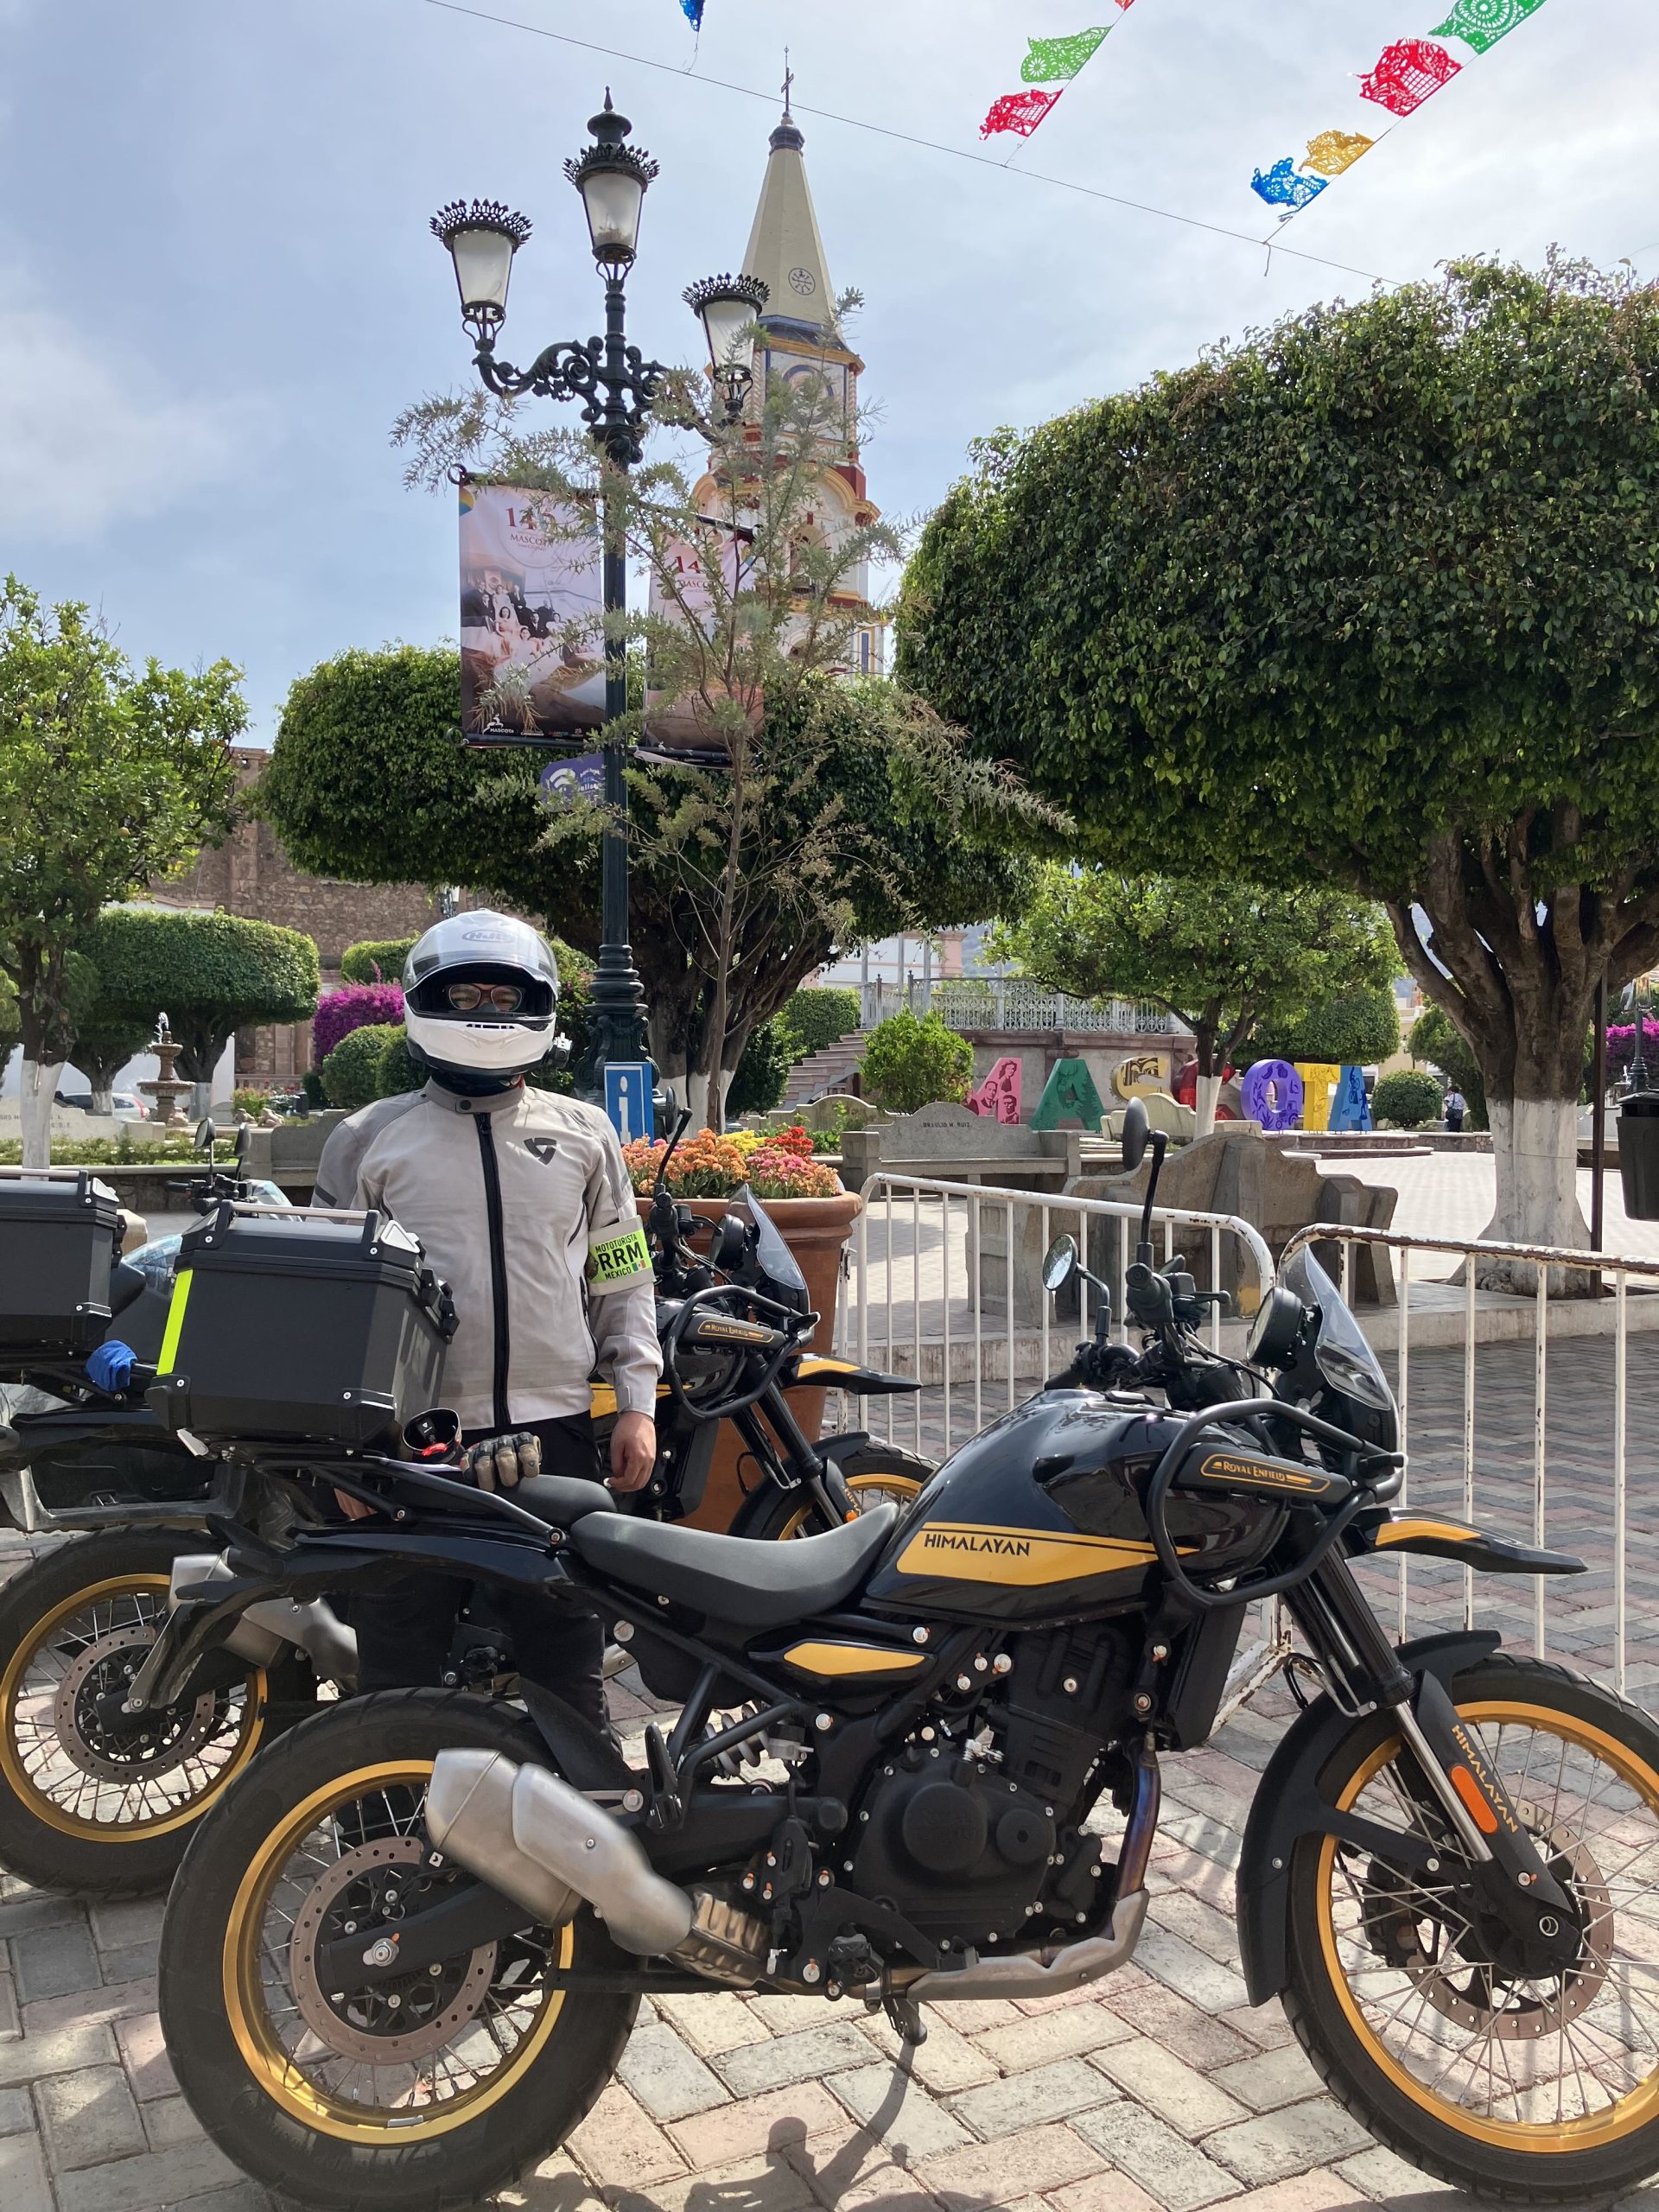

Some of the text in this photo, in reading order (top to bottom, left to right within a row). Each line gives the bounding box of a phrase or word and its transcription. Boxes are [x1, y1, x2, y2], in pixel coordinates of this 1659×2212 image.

[594, 1233, 638, 1254] MOTOTURISTA
[597, 1241, 644, 1271] RRM
[605, 1266, 632, 1280] MEXICO
[925, 1534, 1030, 1556] HIMALAYAN
[1452, 1724, 1519, 1833] HIMALAYAN
